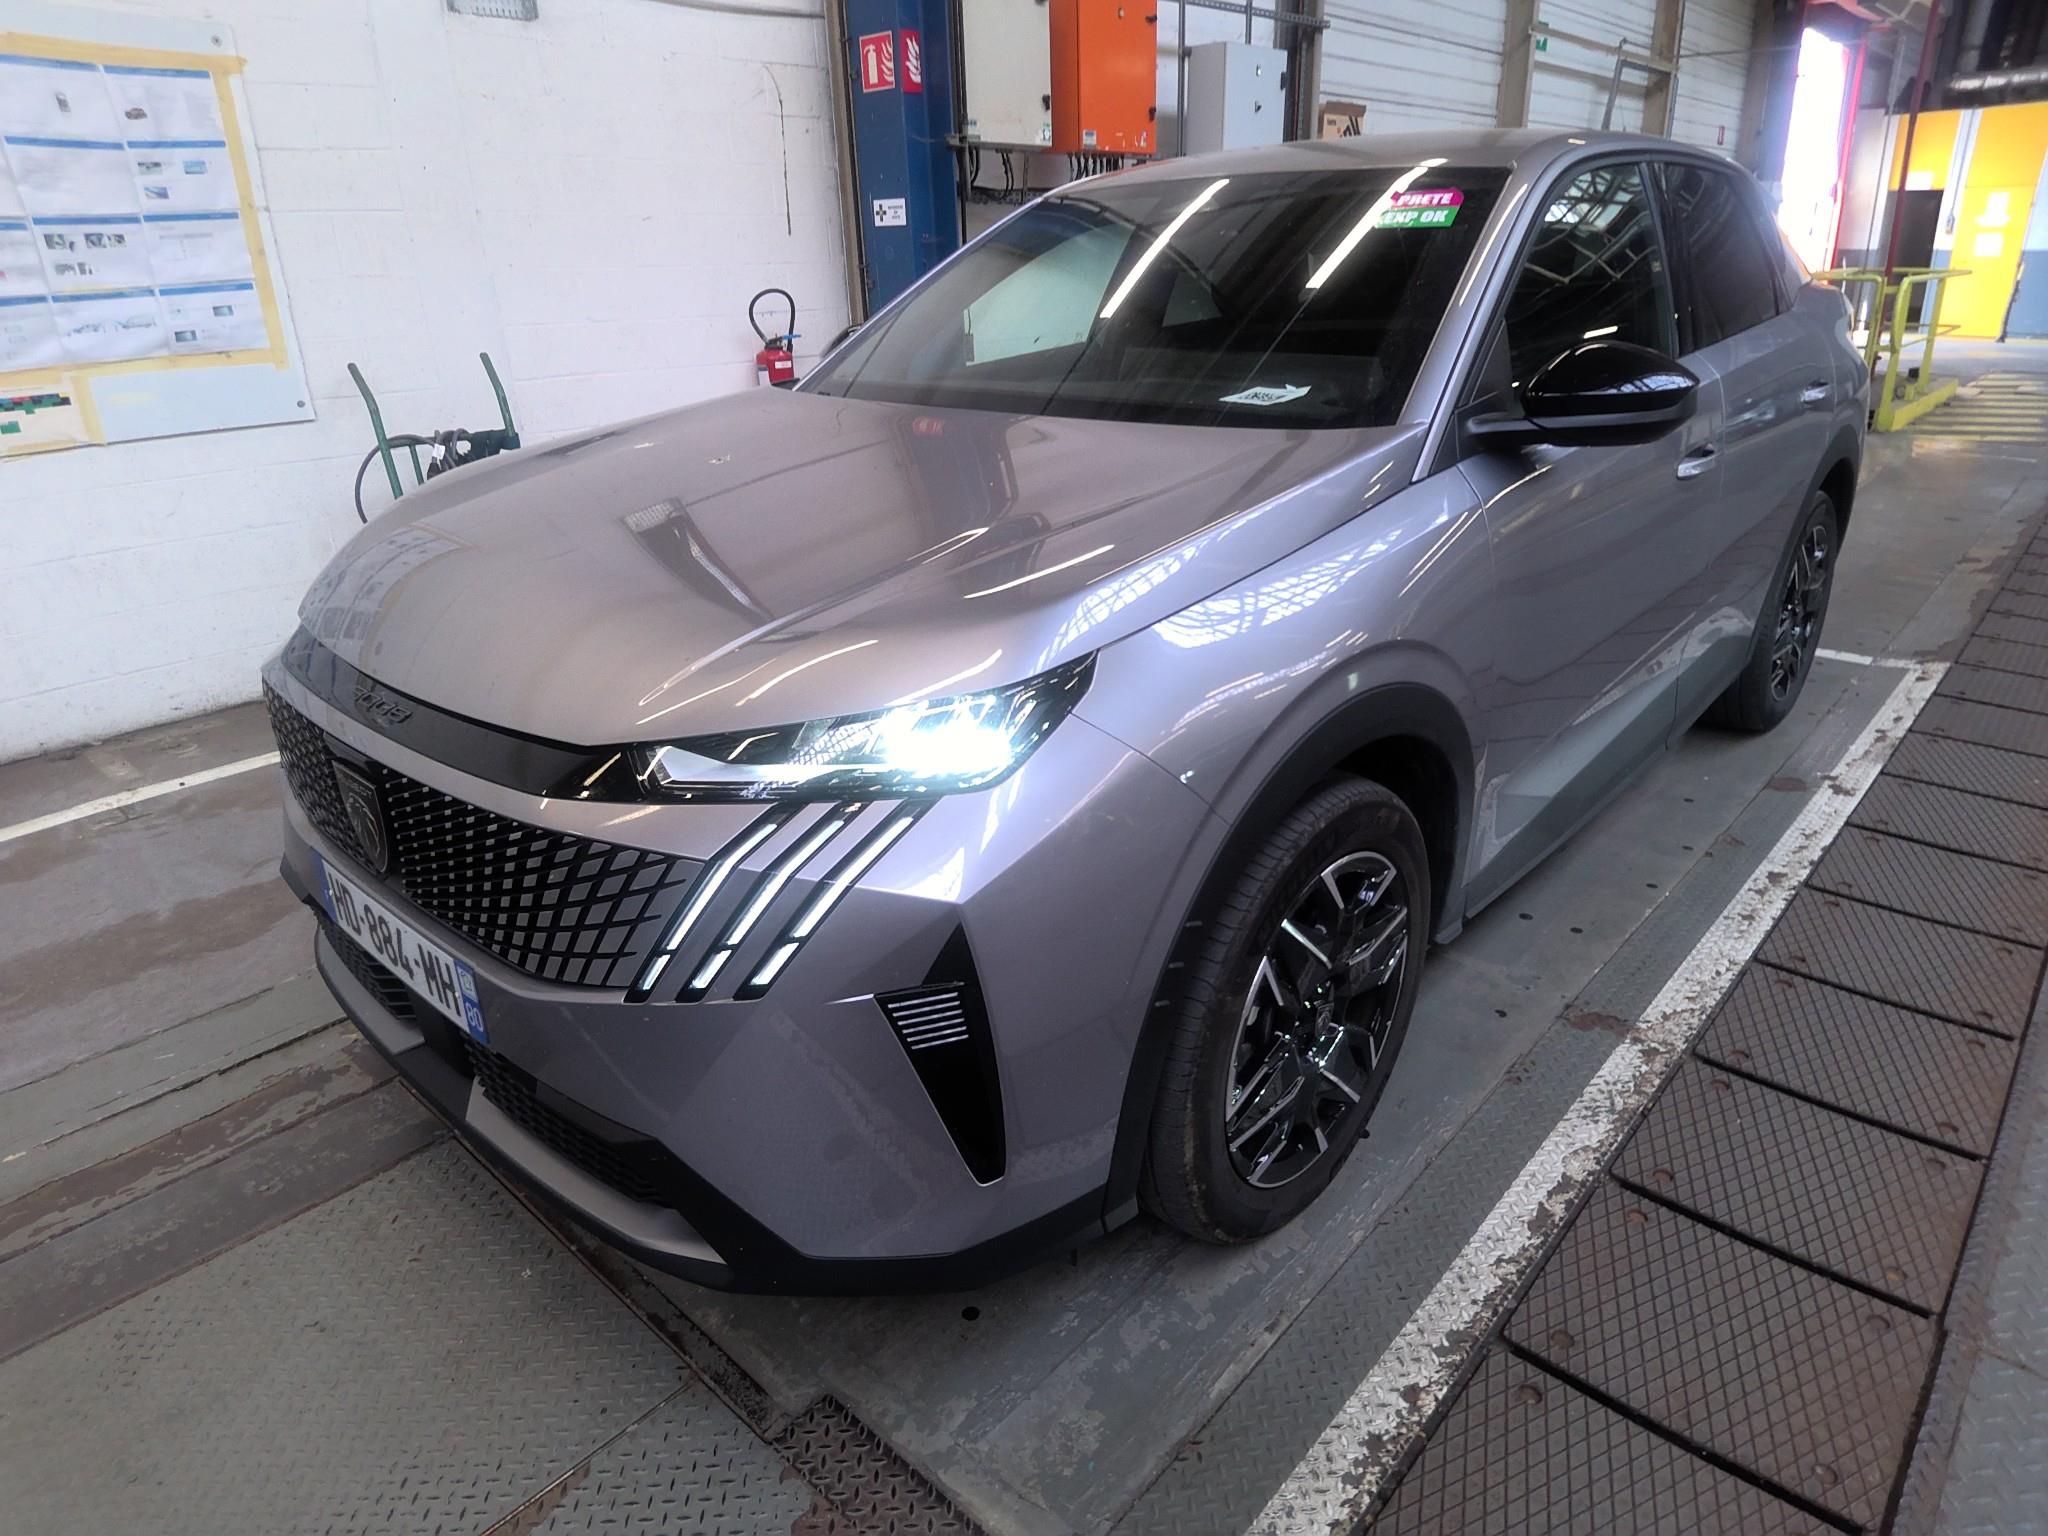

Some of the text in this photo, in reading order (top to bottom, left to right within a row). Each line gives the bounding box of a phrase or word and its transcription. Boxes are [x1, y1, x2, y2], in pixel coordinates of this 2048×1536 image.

[1420, 210, 1449, 223] OK
[328, 872, 462, 1018] HD-884-MH
[465, 1001, 484, 1033] 80
